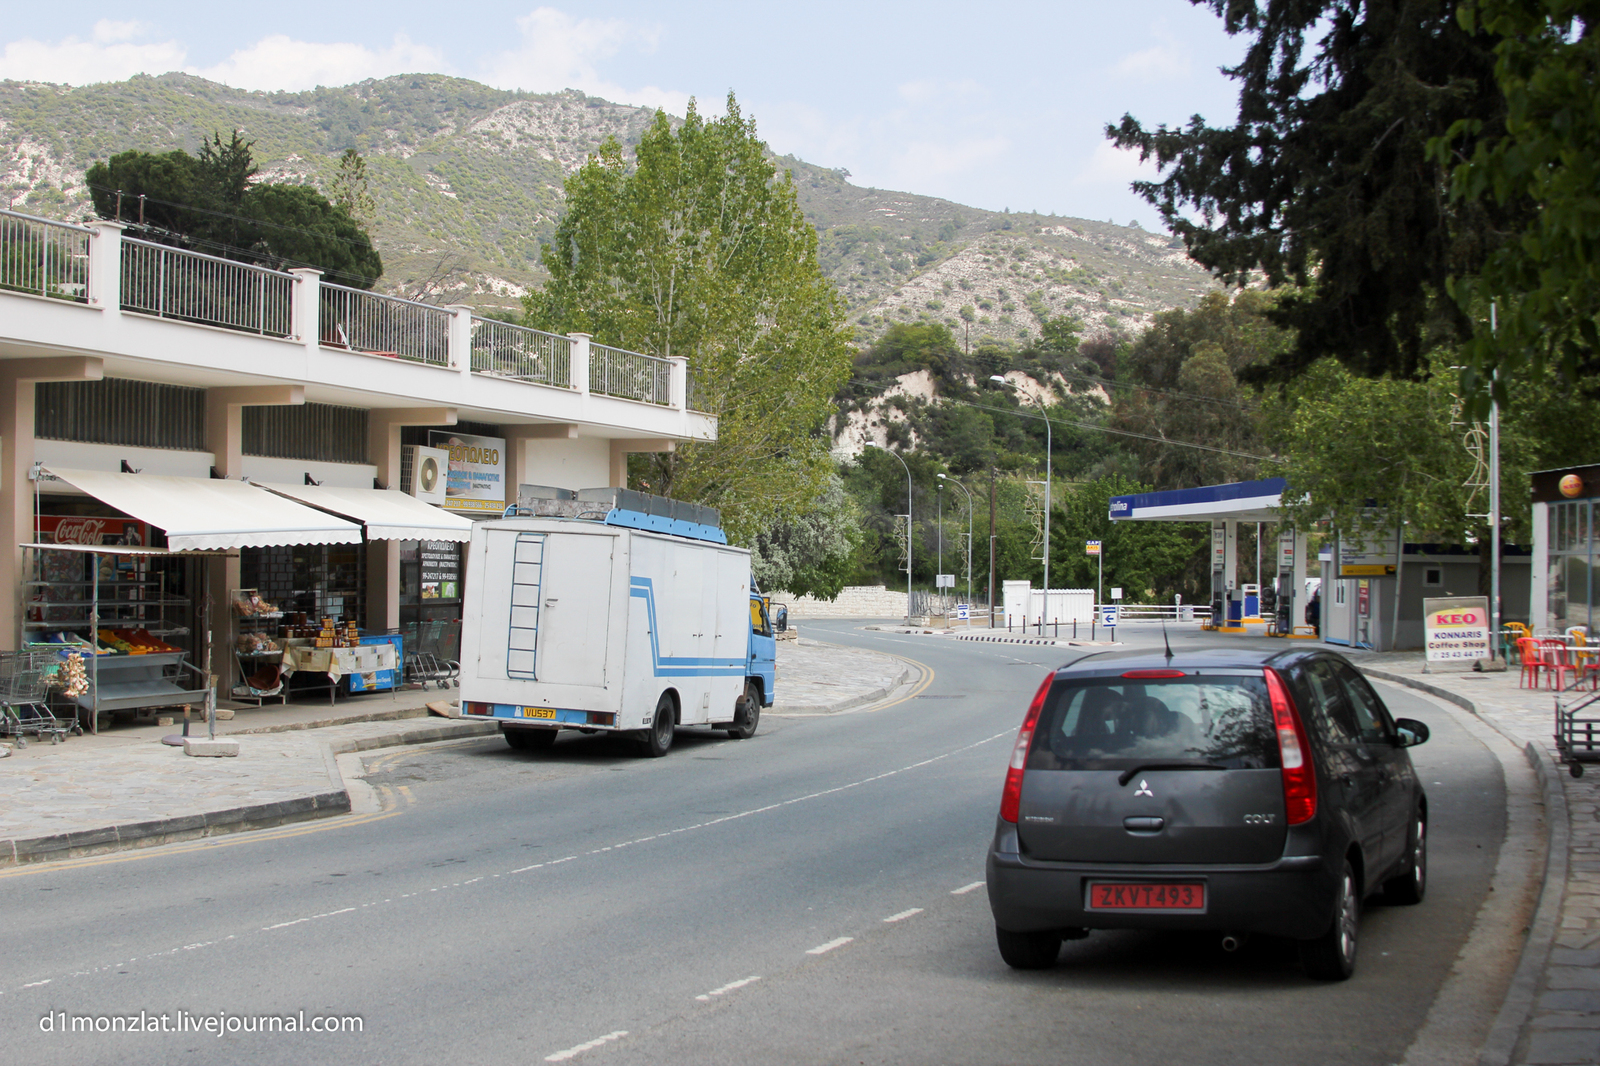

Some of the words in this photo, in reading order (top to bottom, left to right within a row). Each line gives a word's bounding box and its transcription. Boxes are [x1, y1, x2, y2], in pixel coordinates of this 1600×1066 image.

[1436, 614, 1478, 625] KEO
[1434, 631, 1482, 640] KONNARIS
[1243, 814, 1275, 824] COLT
[1101, 886, 1193, 906] ZKVT493
